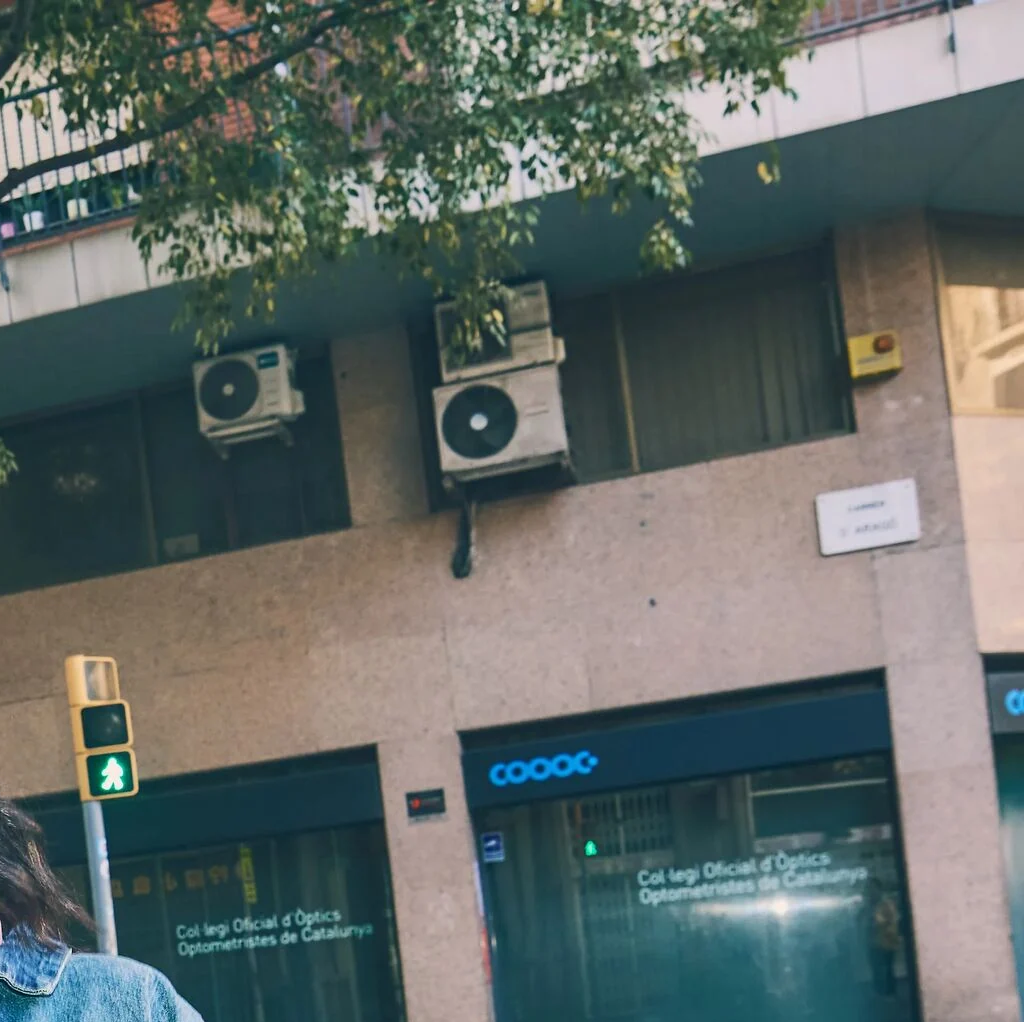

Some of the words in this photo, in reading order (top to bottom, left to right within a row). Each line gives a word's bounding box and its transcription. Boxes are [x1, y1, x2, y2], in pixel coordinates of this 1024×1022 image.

[703, 857, 756, 879] Oficial
[638, 877, 755, 906] Optometristes
[758, 873, 780, 890] de
[783, 865, 868, 888] Catalunya
[233, 915, 278, 933] Oficial
[177, 932, 277, 957] Optometristes
[280, 929, 297, 944] de
[301, 922, 373, 942] Catalunya
